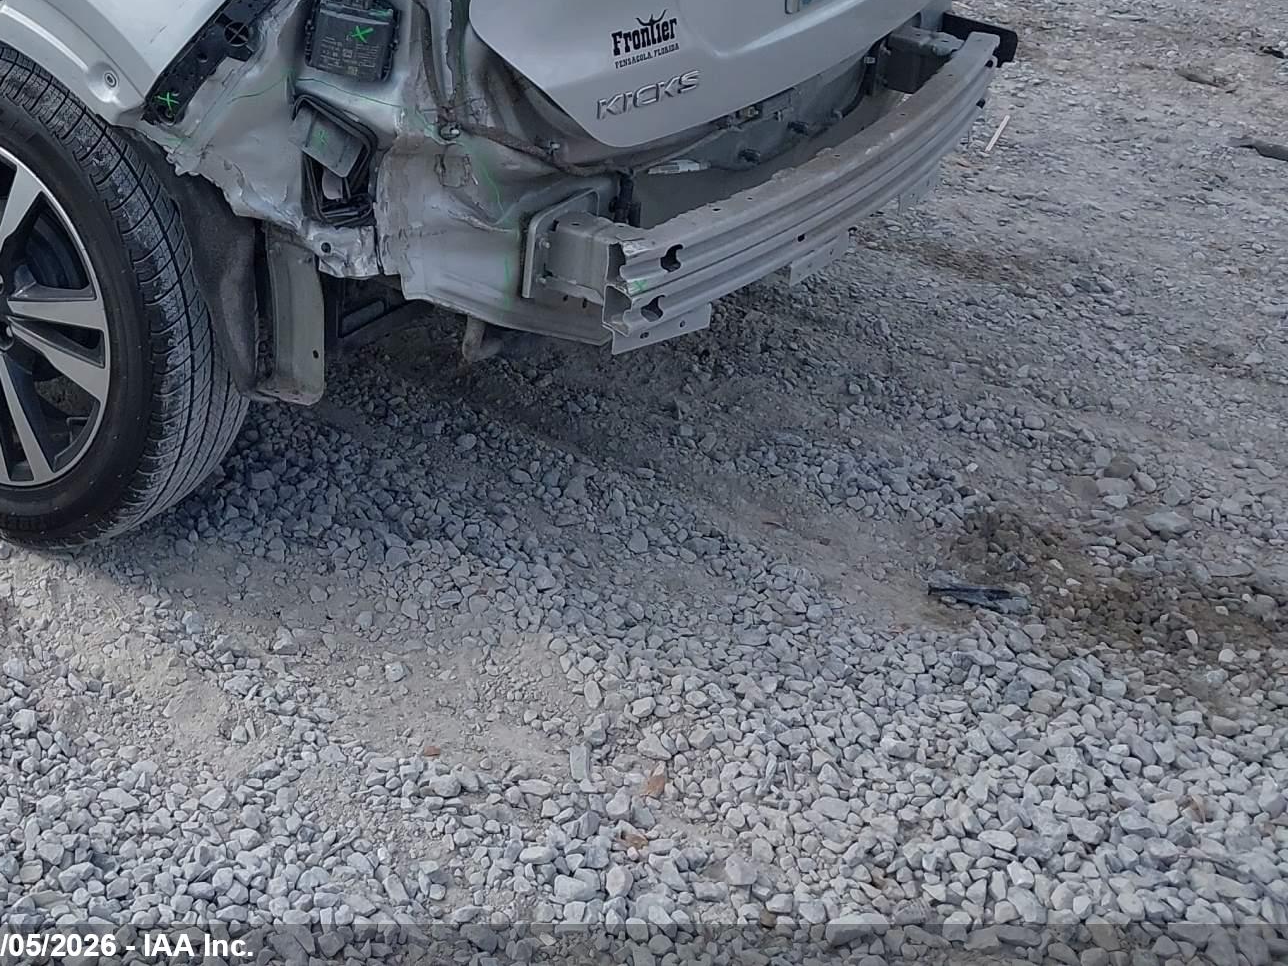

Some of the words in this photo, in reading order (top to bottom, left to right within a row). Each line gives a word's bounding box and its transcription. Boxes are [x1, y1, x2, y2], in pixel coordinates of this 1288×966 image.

[611, 16, 678, 56] Frontier
[654, 43, 680, 57] FLORIDA
[596, 70, 702, 120] KICKS
